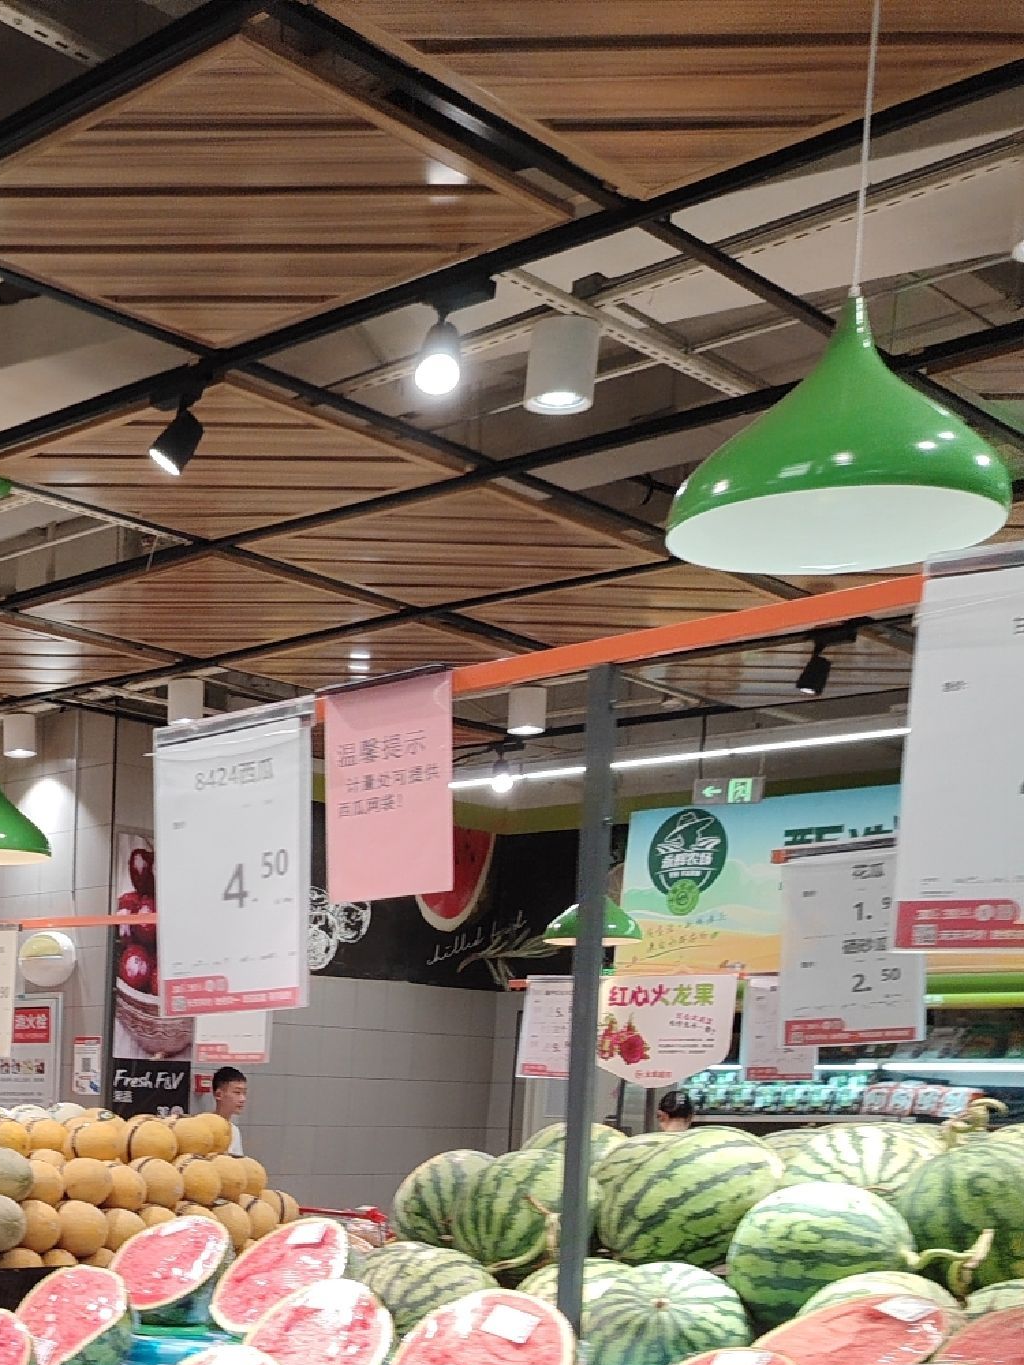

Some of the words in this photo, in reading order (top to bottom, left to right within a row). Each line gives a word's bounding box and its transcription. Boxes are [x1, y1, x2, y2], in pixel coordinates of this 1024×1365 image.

[337, 730, 427, 768] 温馨提示
[195, 757, 274, 791] 8424西瓜
[345, 763, 441, 793] 计量处可提供
[608, 983, 715, 1006] 红心火龙果
[112, 1068, 154, 1089] Fresh
